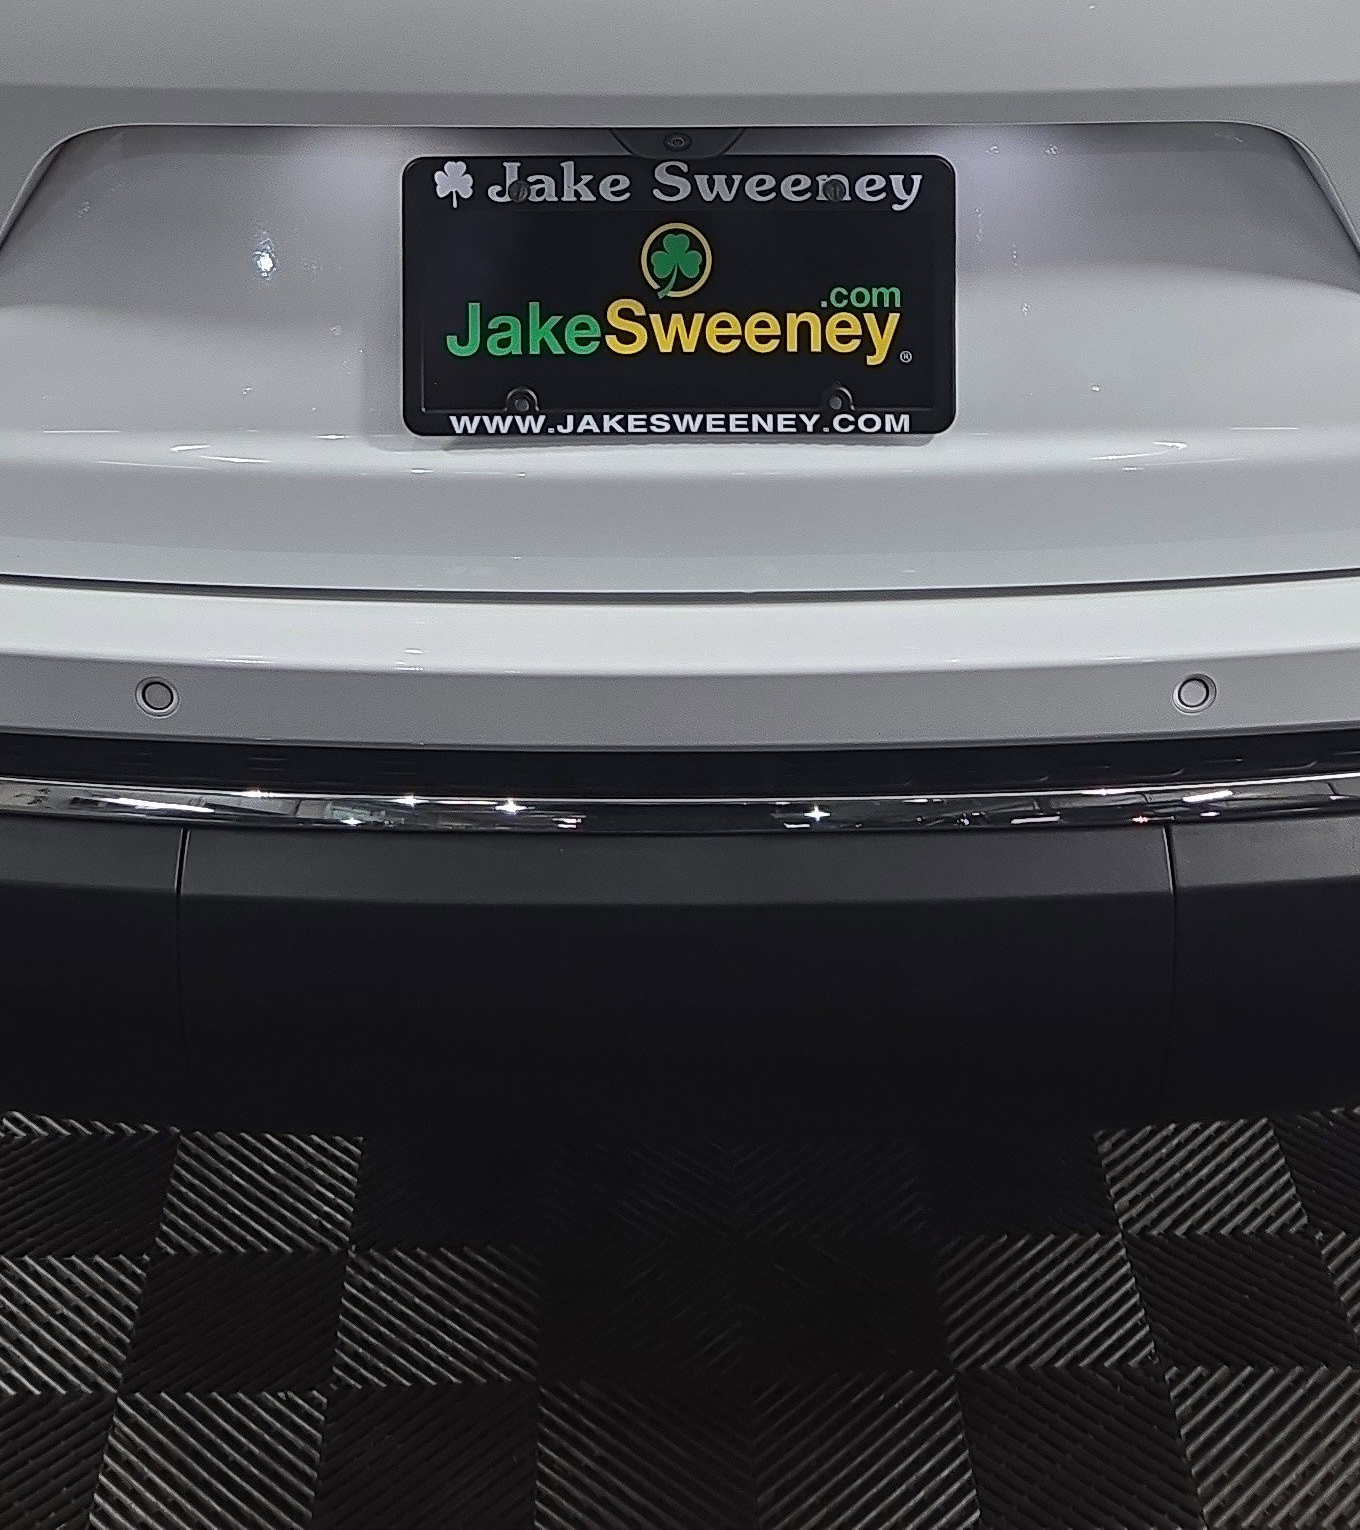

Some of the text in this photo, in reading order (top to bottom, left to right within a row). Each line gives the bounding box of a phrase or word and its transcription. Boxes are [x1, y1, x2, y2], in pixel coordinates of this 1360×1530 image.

[487, 161, 924, 212] Jake Sweeney
[448, 412, 911, 435] WWW.JAKESWEENEY.COM
